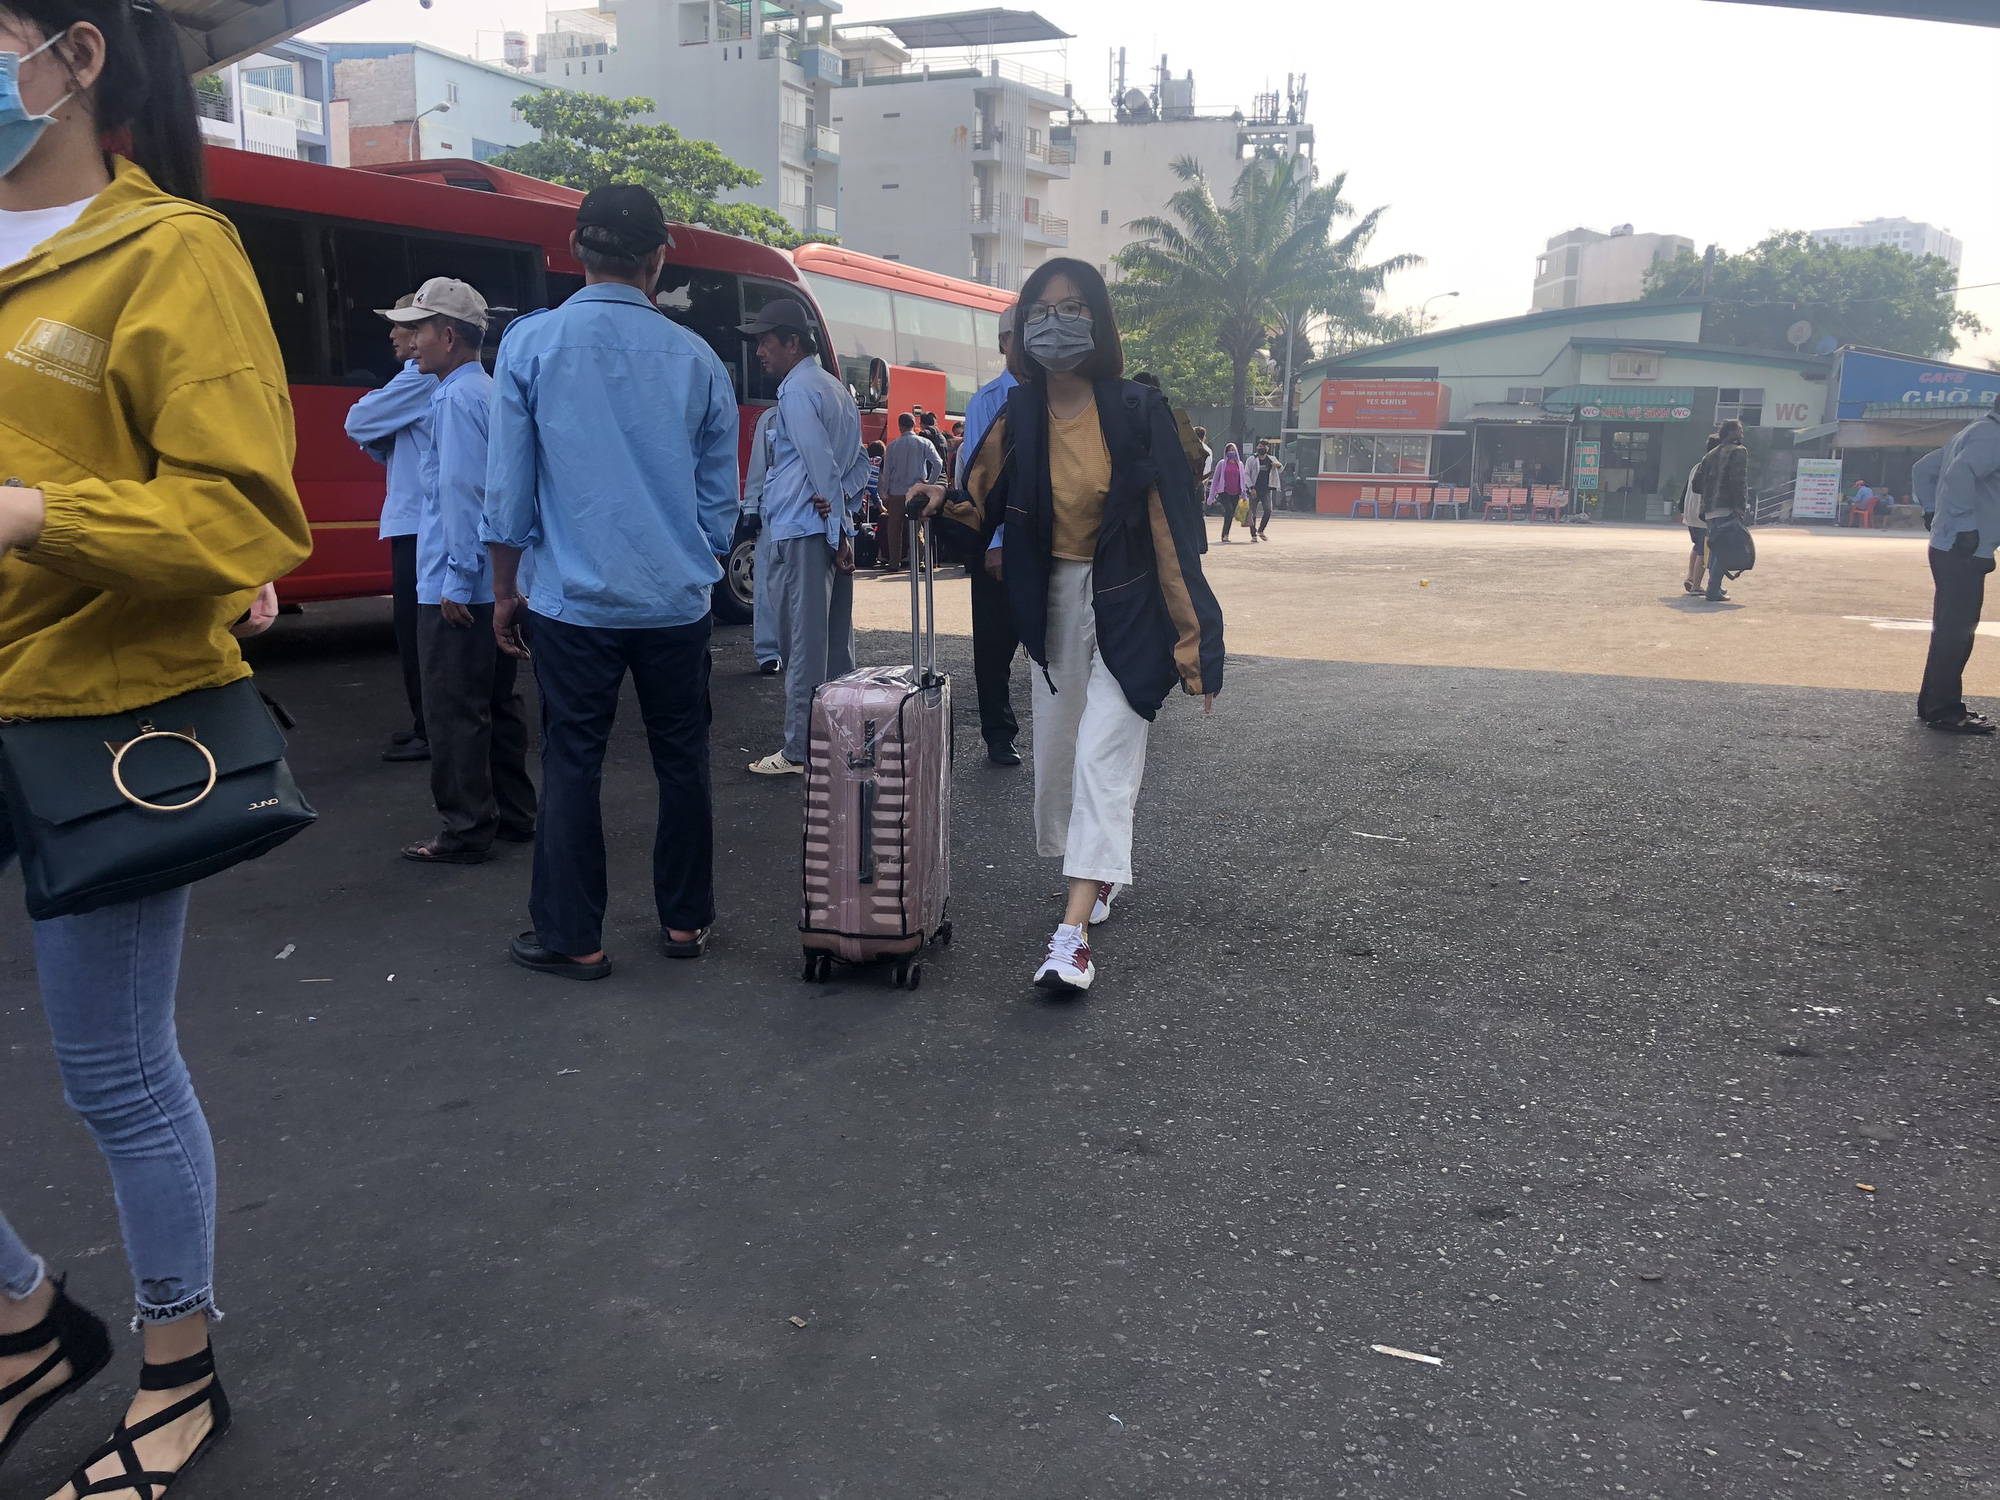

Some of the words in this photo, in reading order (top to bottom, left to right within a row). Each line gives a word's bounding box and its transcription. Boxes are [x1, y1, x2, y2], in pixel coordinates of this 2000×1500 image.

[5, 351, 32, 367] New
[35, 363, 101, 393] Collection
[1582, 408, 1597, 416] WC
[1627, 406, 1641, 420] VỆ
[1644, 407, 1670, 418] SINH
[1673, 409, 1689, 417] WC
[1775, 403, 1809, 421] WC
[1581, 467, 1598, 475] SINH
[1582, 477, 1595, 486] WC
[248, 798, 278, 810] JUNO
[138, 1294, 208, 1319] CHANEL
